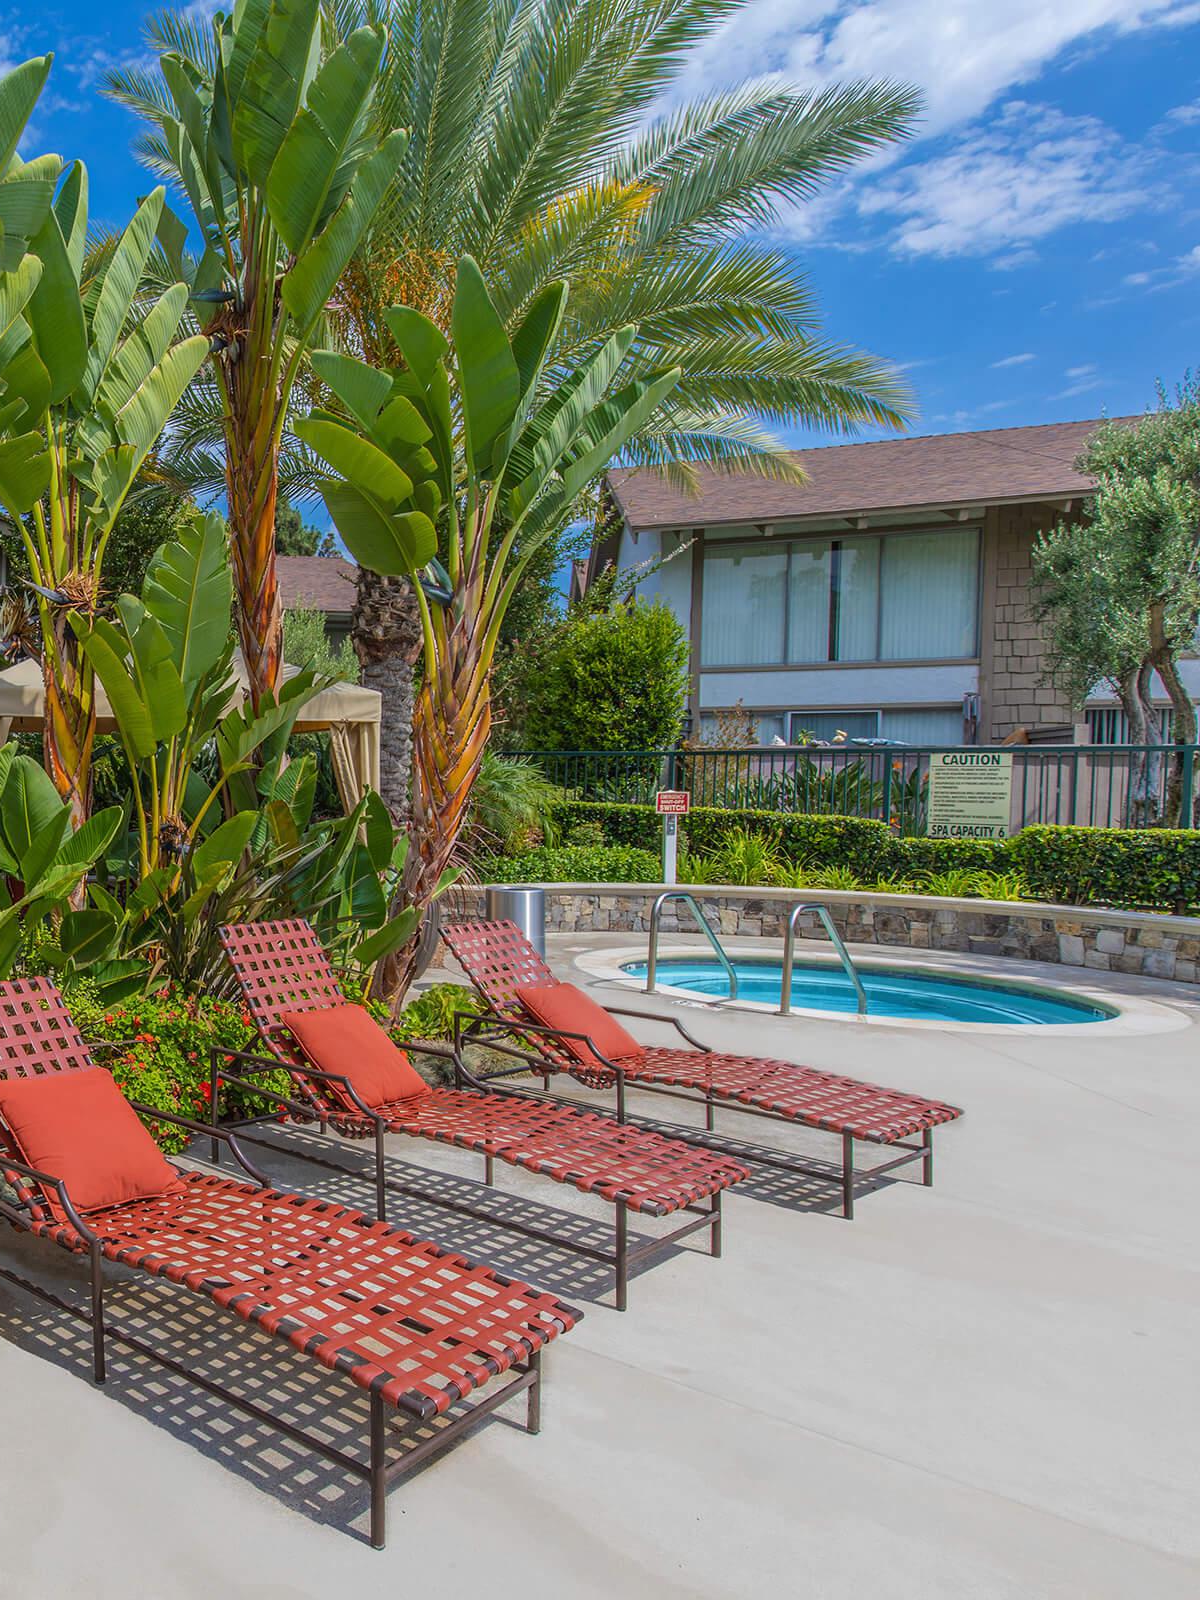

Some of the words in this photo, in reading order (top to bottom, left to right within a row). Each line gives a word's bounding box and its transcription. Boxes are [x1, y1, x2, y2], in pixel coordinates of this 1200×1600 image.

[942, 754, 1001, 765] CAUTION
[931, 824, 949, 836] SPA
[950, 825, 994, 838] CAPACITY
[998, 827, 1005, 838] 6
